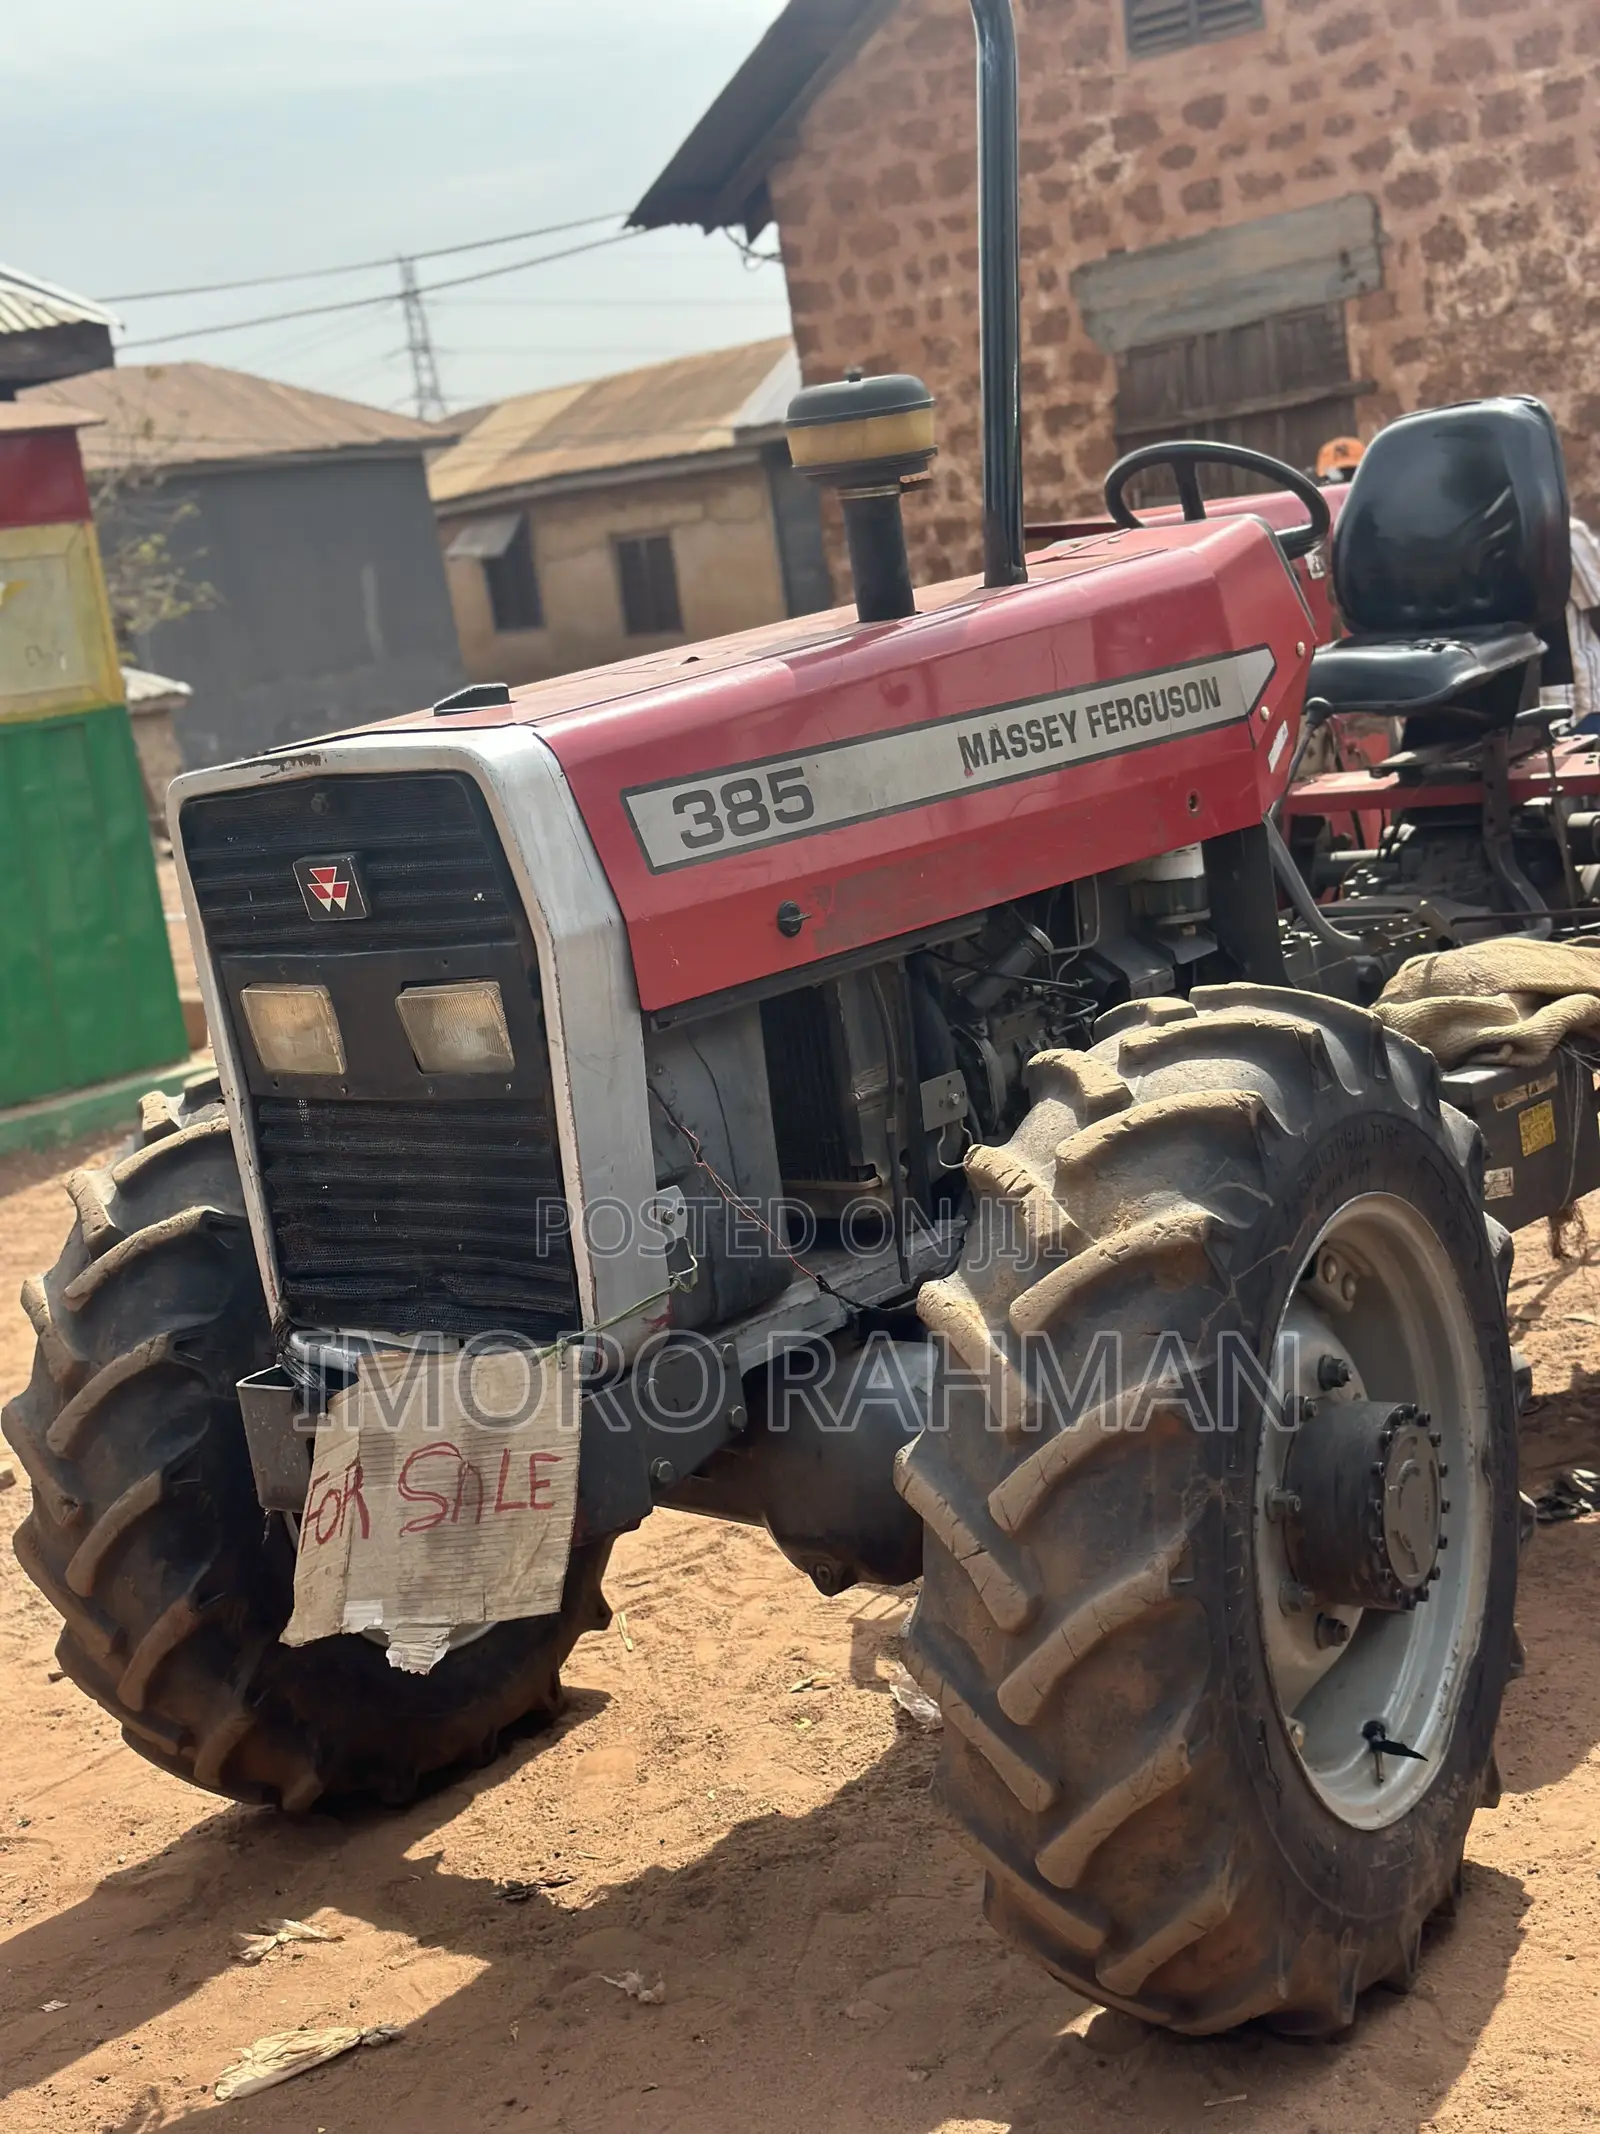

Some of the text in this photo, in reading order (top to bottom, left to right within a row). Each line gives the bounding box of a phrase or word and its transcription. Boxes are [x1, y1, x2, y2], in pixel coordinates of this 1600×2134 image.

[957, 676, 1222, 769] MASSEY FERGUSON
[672, 766, 815, 849] 385
[300, 1441, 563, 1554] FOR SALE
